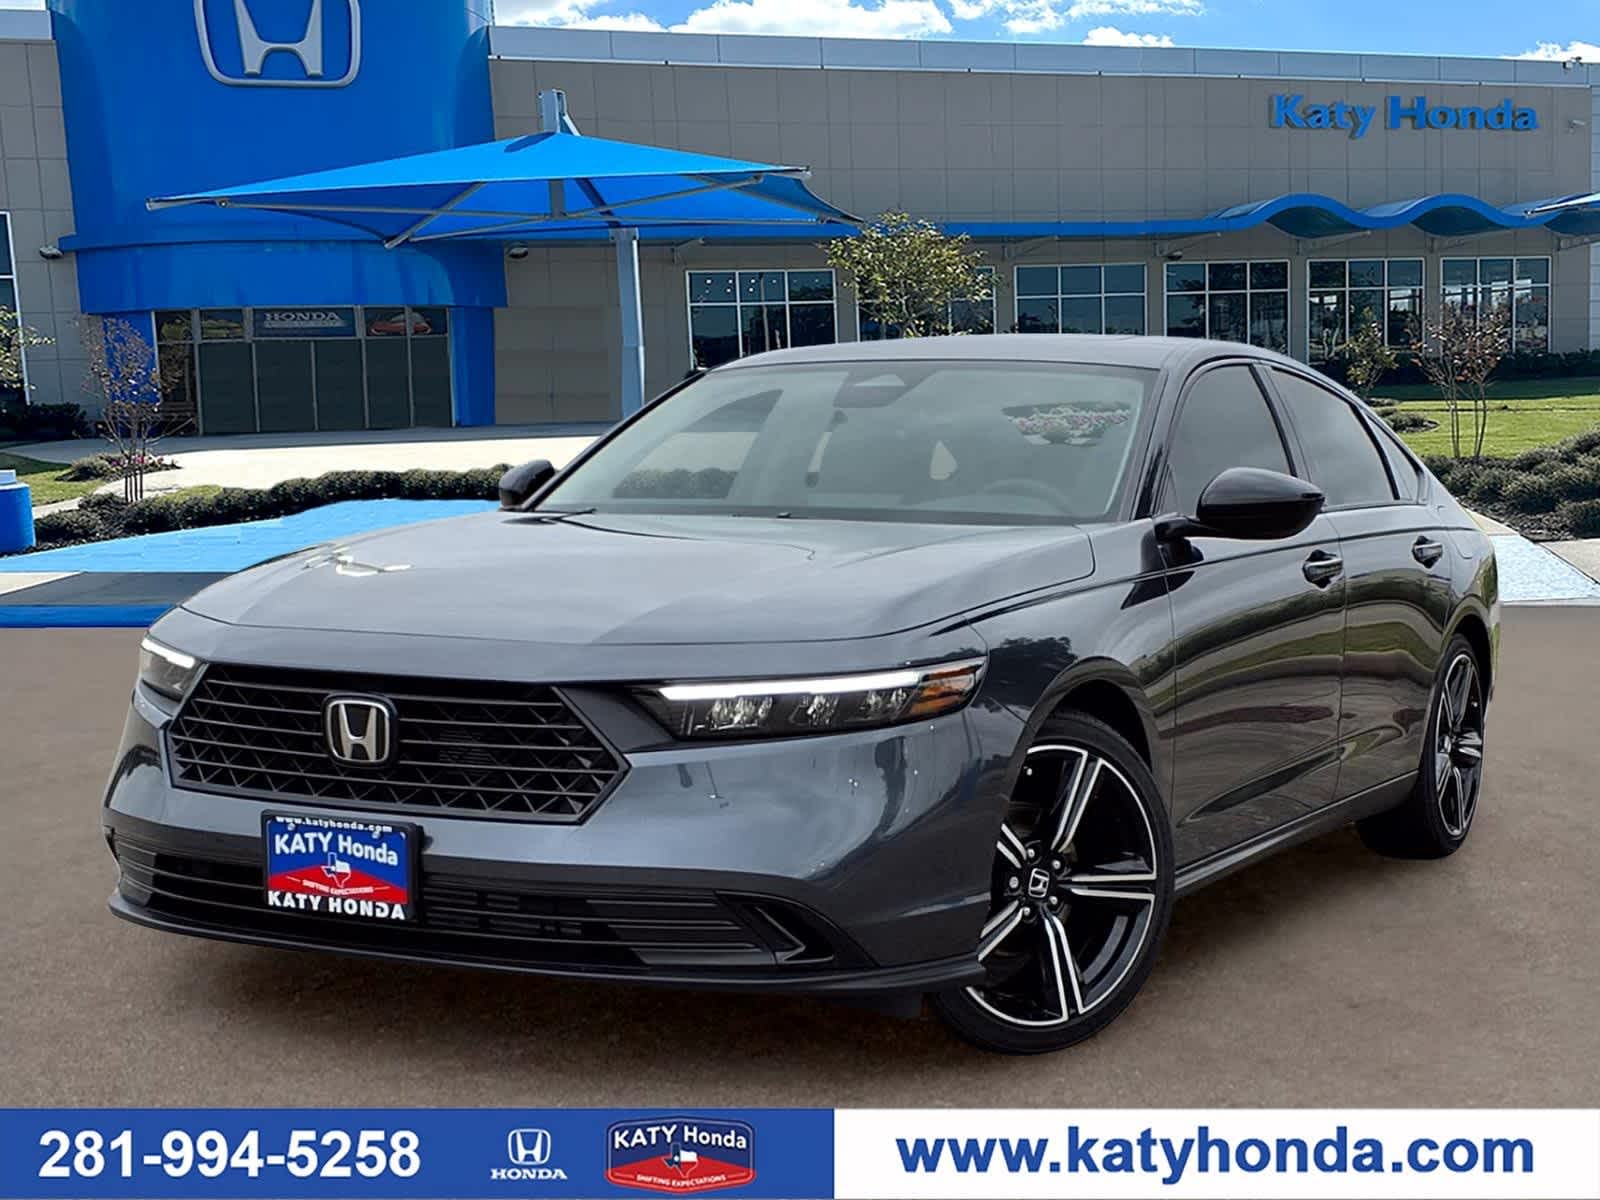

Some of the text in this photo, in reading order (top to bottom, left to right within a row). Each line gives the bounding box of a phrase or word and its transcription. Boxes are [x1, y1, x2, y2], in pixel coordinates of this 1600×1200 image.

[1269, 94, 1540, 139] Katy Honda
[264, 311, 341, 321] HONDA
[275, 816, 392, 832] www.katyhonda.com
[275, 832, 398, 866] KATY Honda
[268, 890, 405, 920] KATY HONDA
